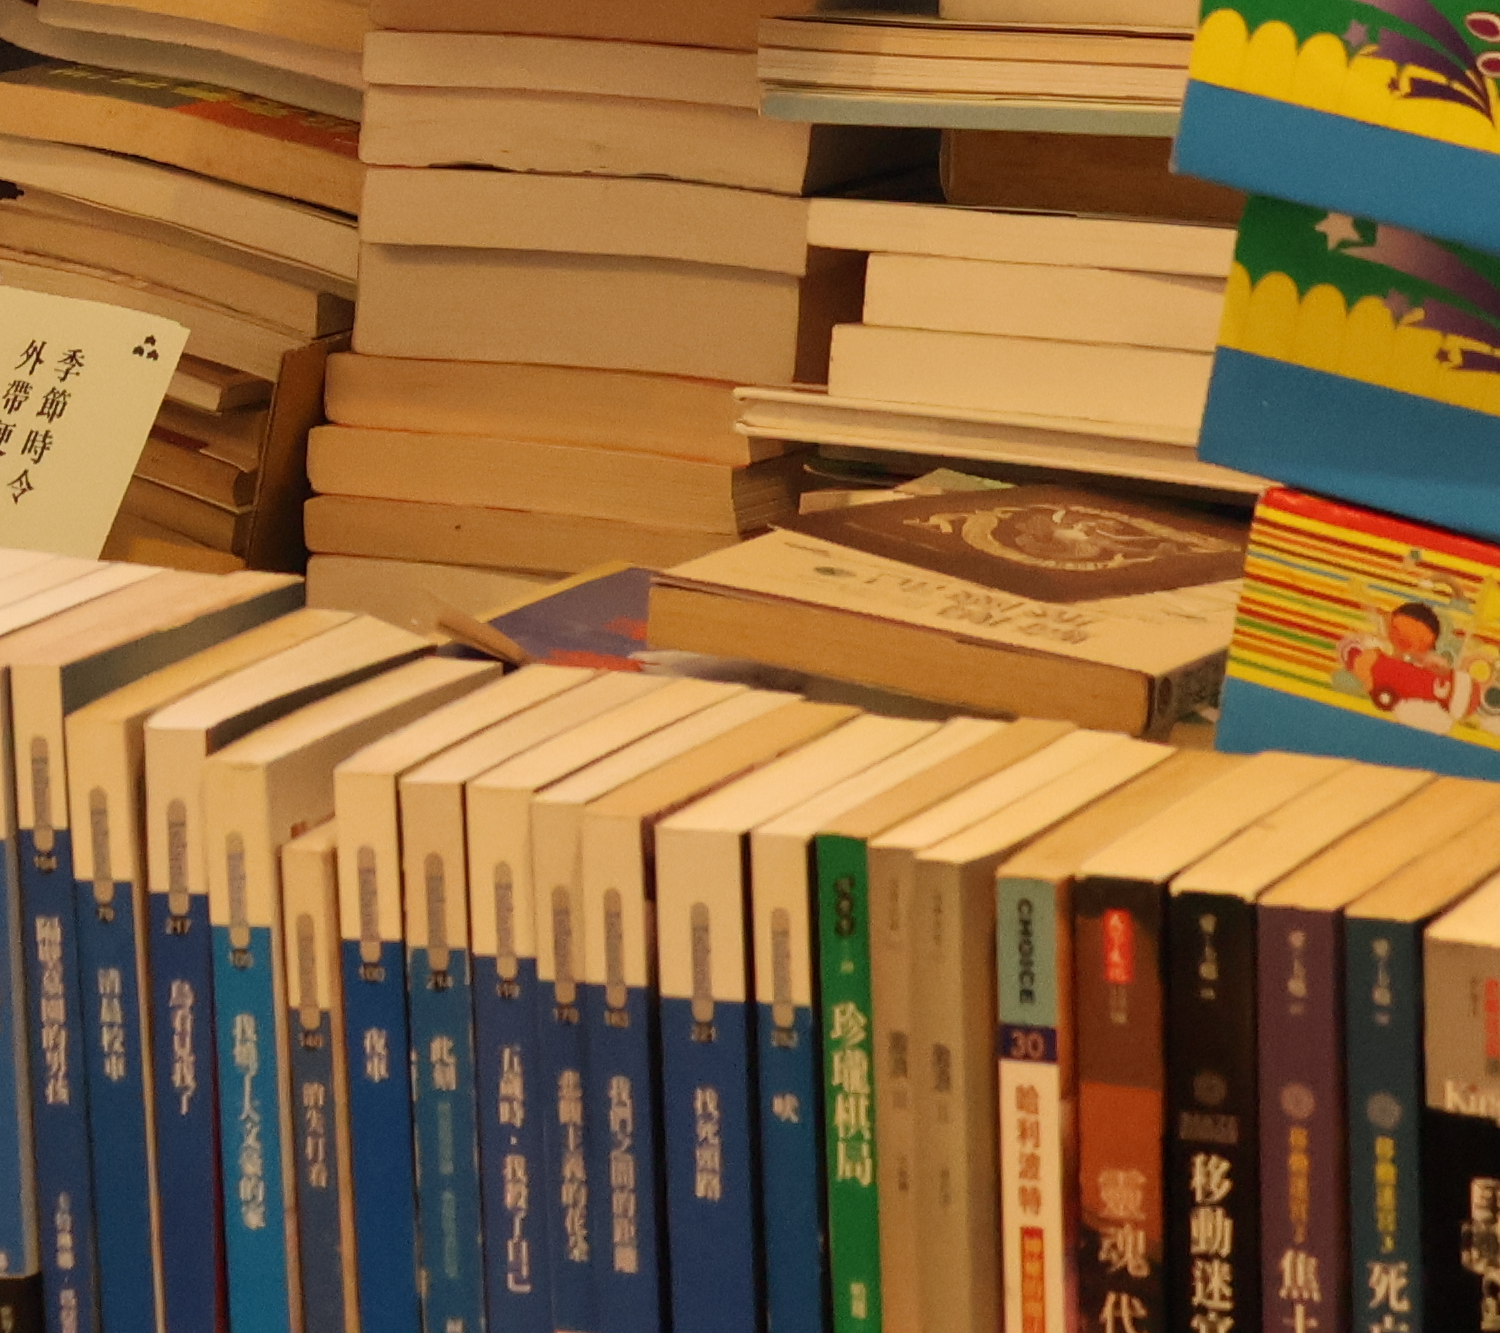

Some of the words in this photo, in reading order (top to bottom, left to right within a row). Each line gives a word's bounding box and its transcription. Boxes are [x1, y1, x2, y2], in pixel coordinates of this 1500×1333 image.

[7, 348, 85, 505] 季節時令
[1017, 898, 1036, 1005] CHOICE
[830, 1001, 873, 1188] 珍瓏棋局
[1011, 1035, 1043, 1058] 30
